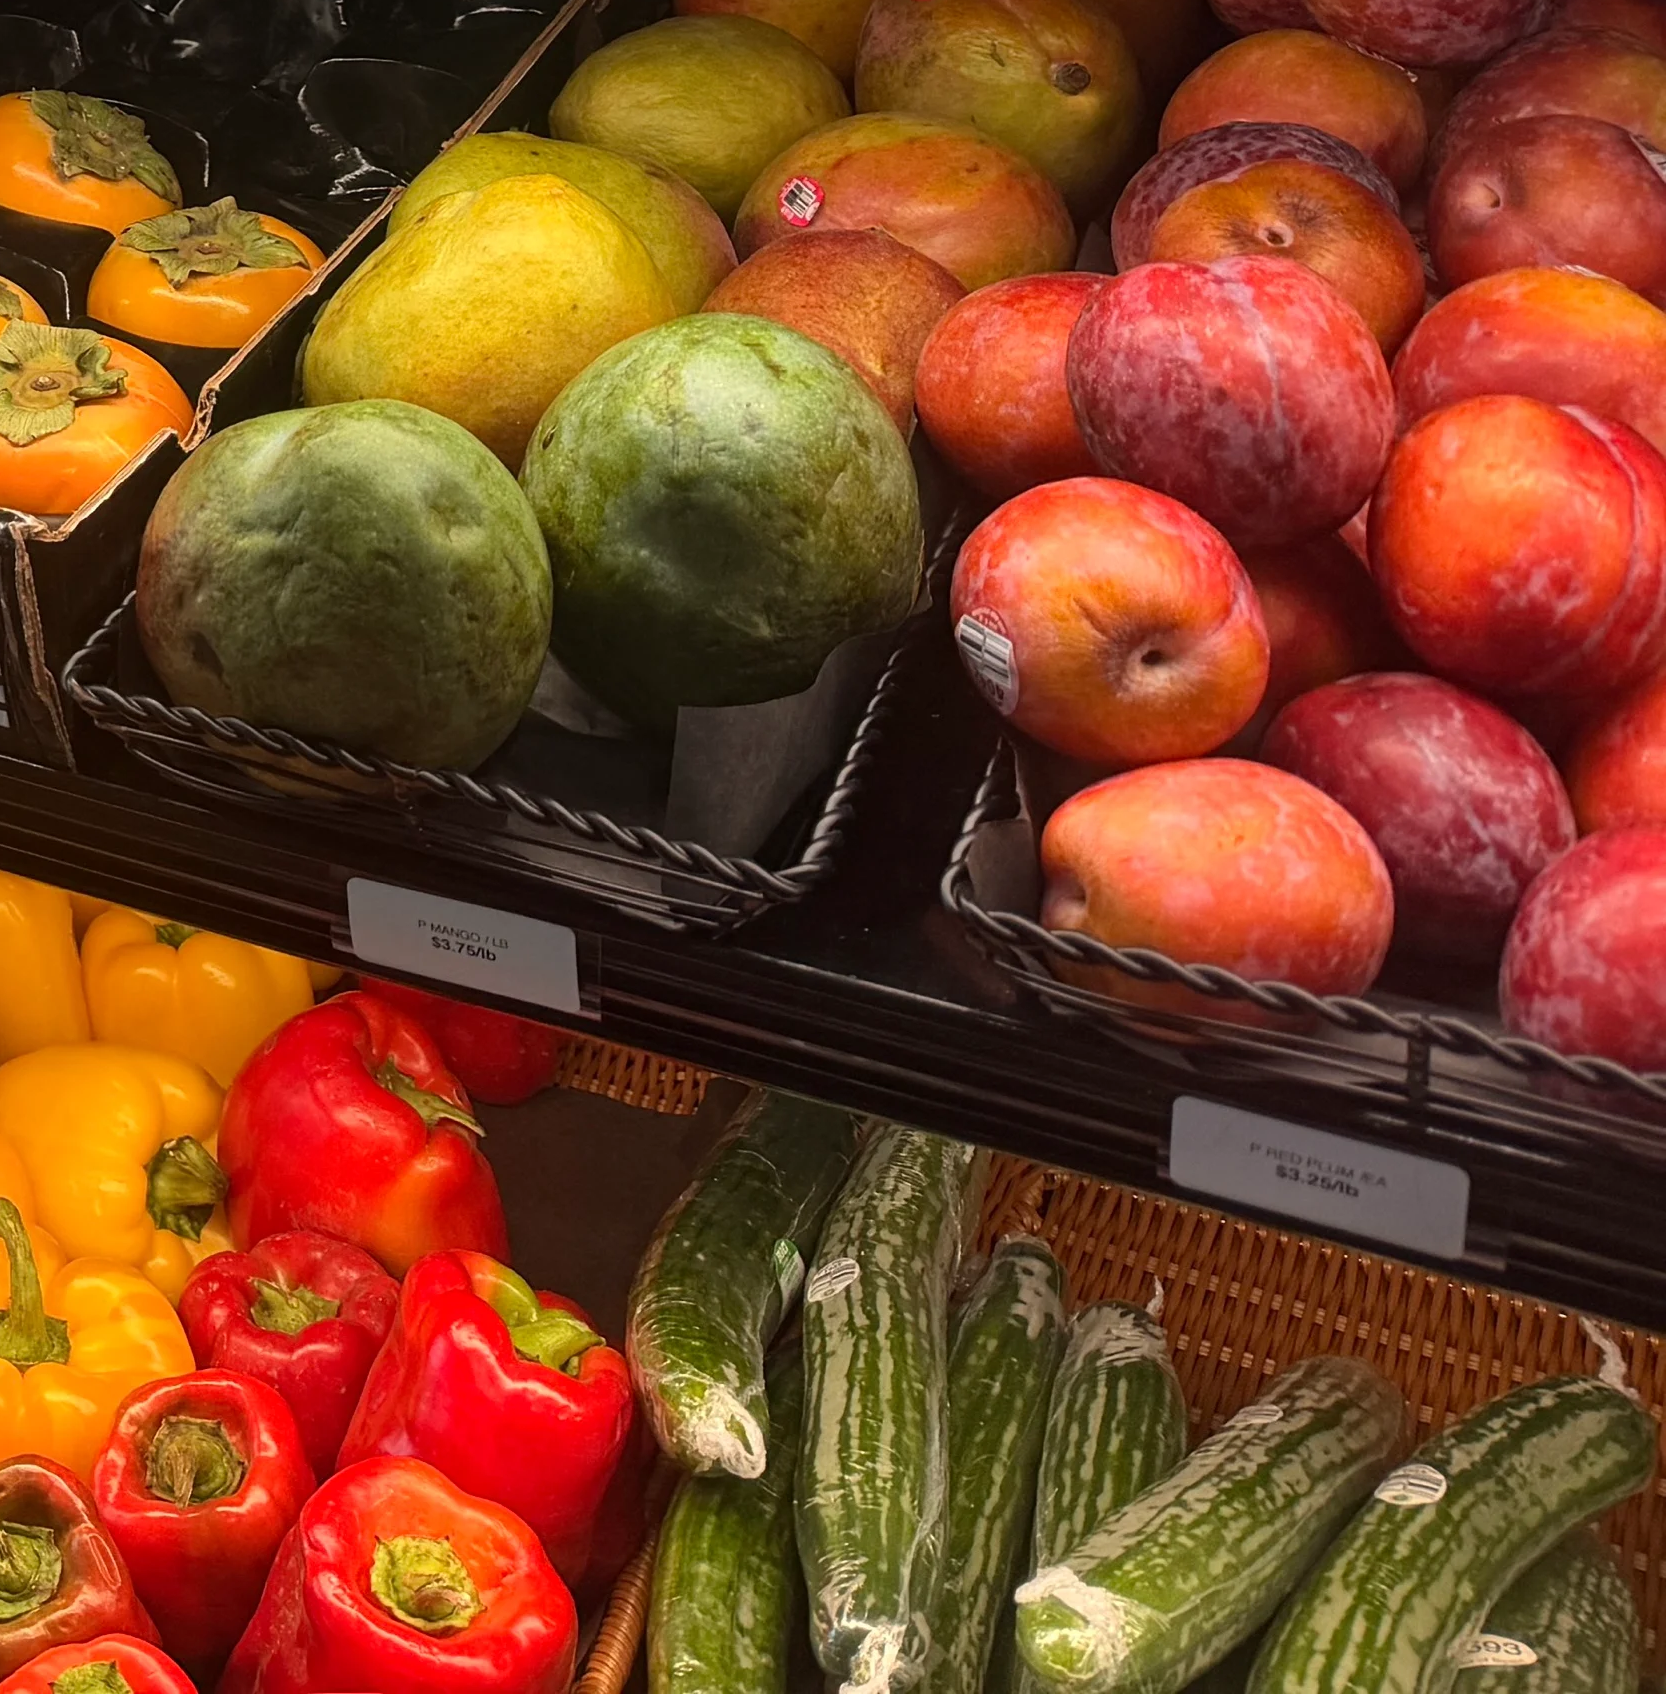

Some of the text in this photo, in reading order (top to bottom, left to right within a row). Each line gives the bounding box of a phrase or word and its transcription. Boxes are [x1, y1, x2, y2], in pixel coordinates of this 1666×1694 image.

[417, 919, 510, 951] P MANGO LB
[430, 936, 498, 963] $3.75/lb
[1250, 1141, 1356, 1179] P RED PLUM
[1275, 1163, 1360, 1198] $3.25/lb
